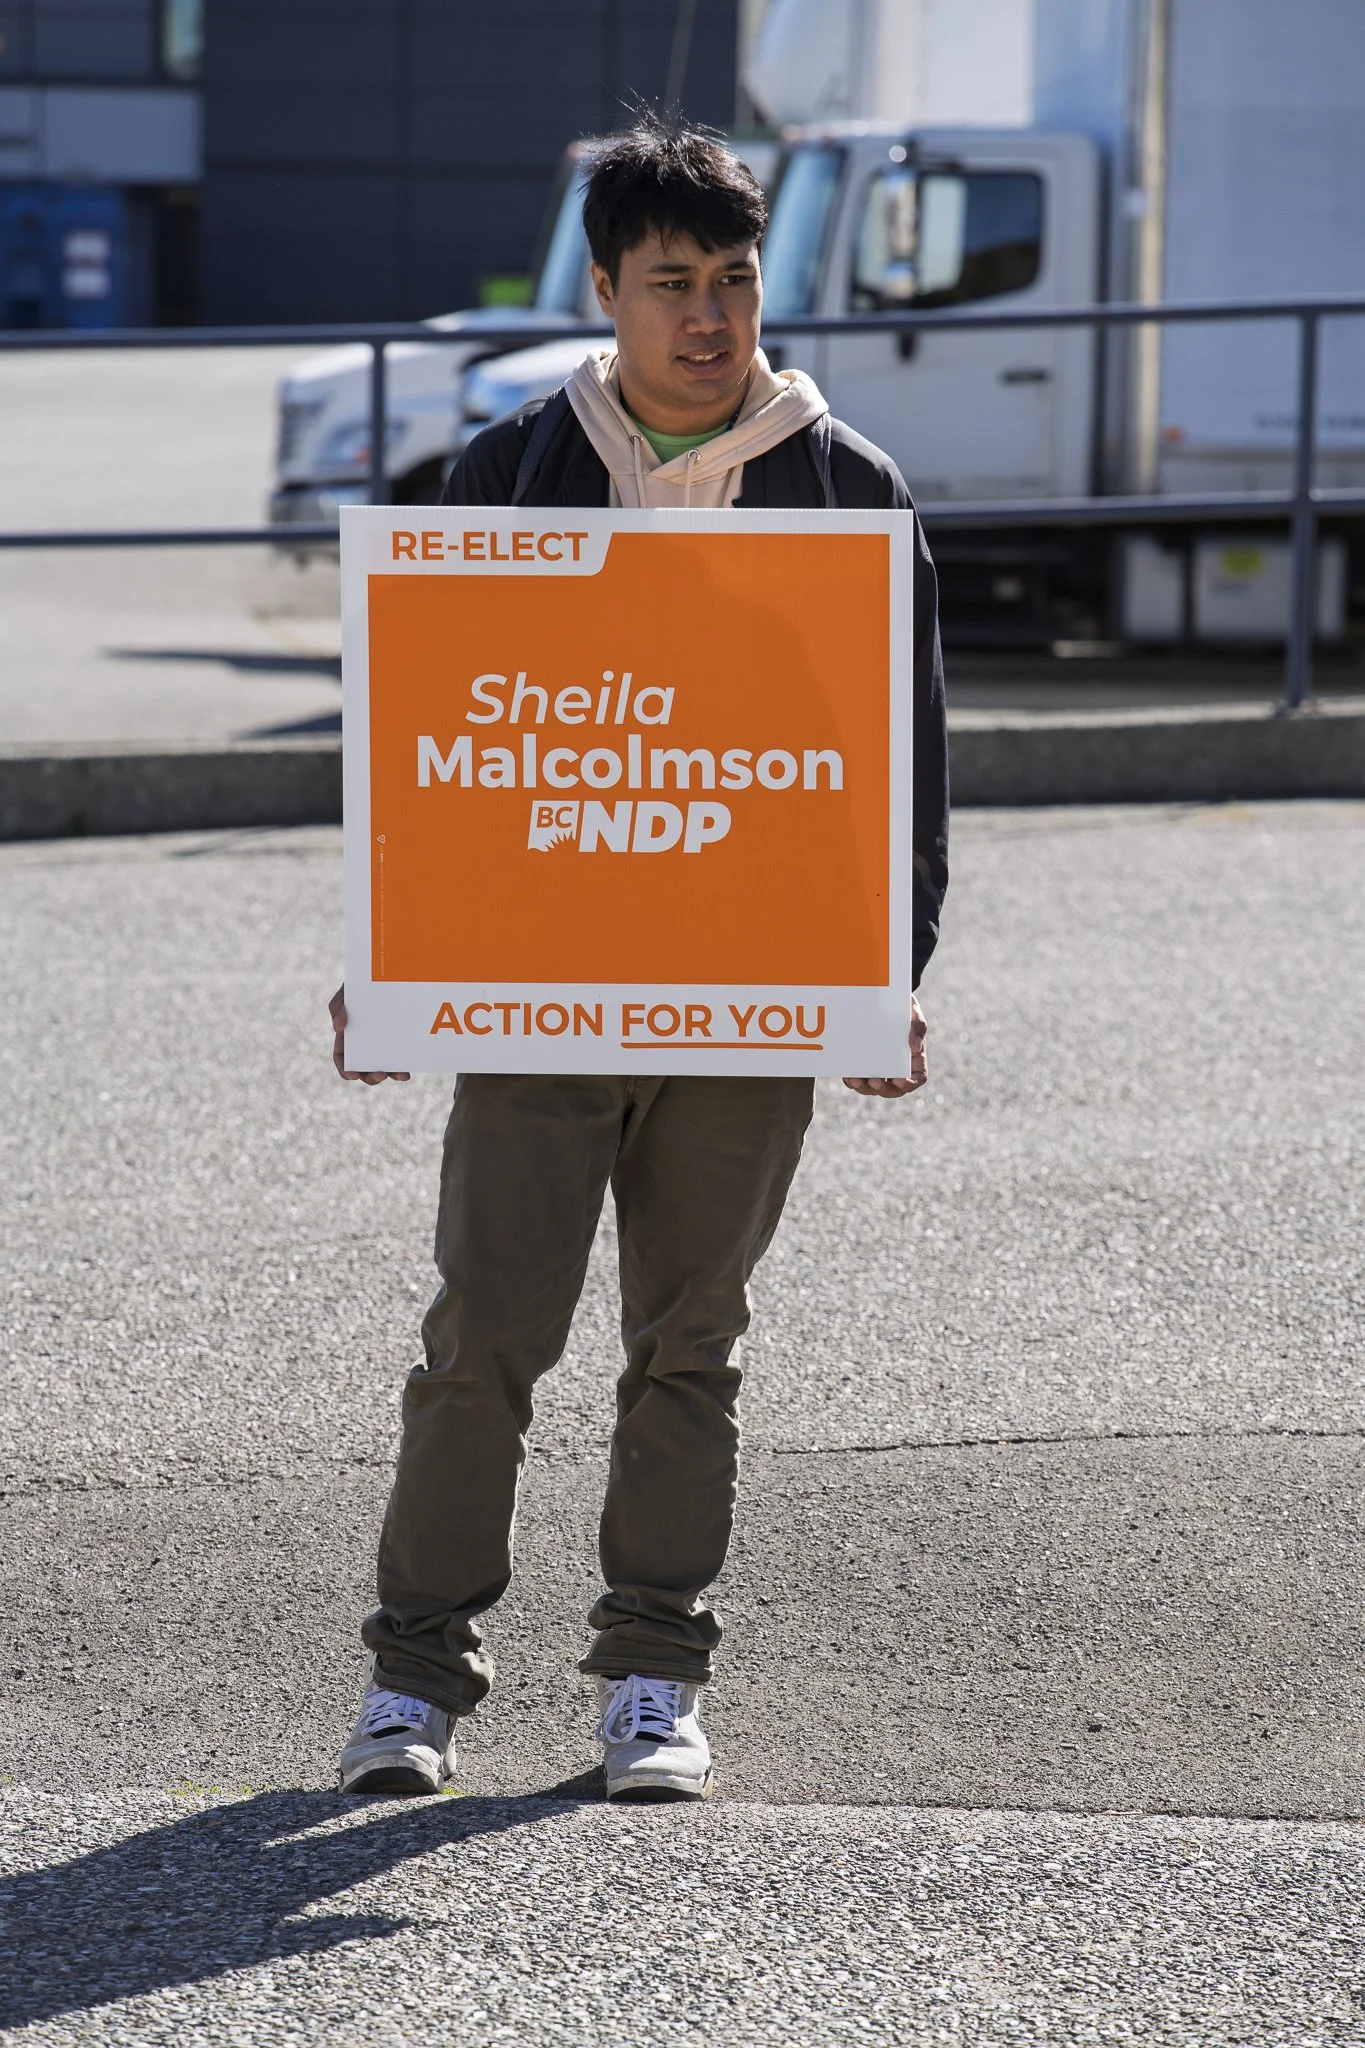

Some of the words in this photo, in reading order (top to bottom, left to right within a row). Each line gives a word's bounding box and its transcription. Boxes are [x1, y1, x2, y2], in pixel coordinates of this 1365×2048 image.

[392, 531, 588, 561] RE-ELECT
[466, 671, 675, 725] Sheila
[418, 734, 844, 790] Malcolmson
[536, 806, 573, 829] BC
[579, 801, 732, 854] NDP
[431, 1002, 603, 1036] ACTION
[622, 1004, 712, 1037] FOR
[729, 1005, 826, 1038] YOU
